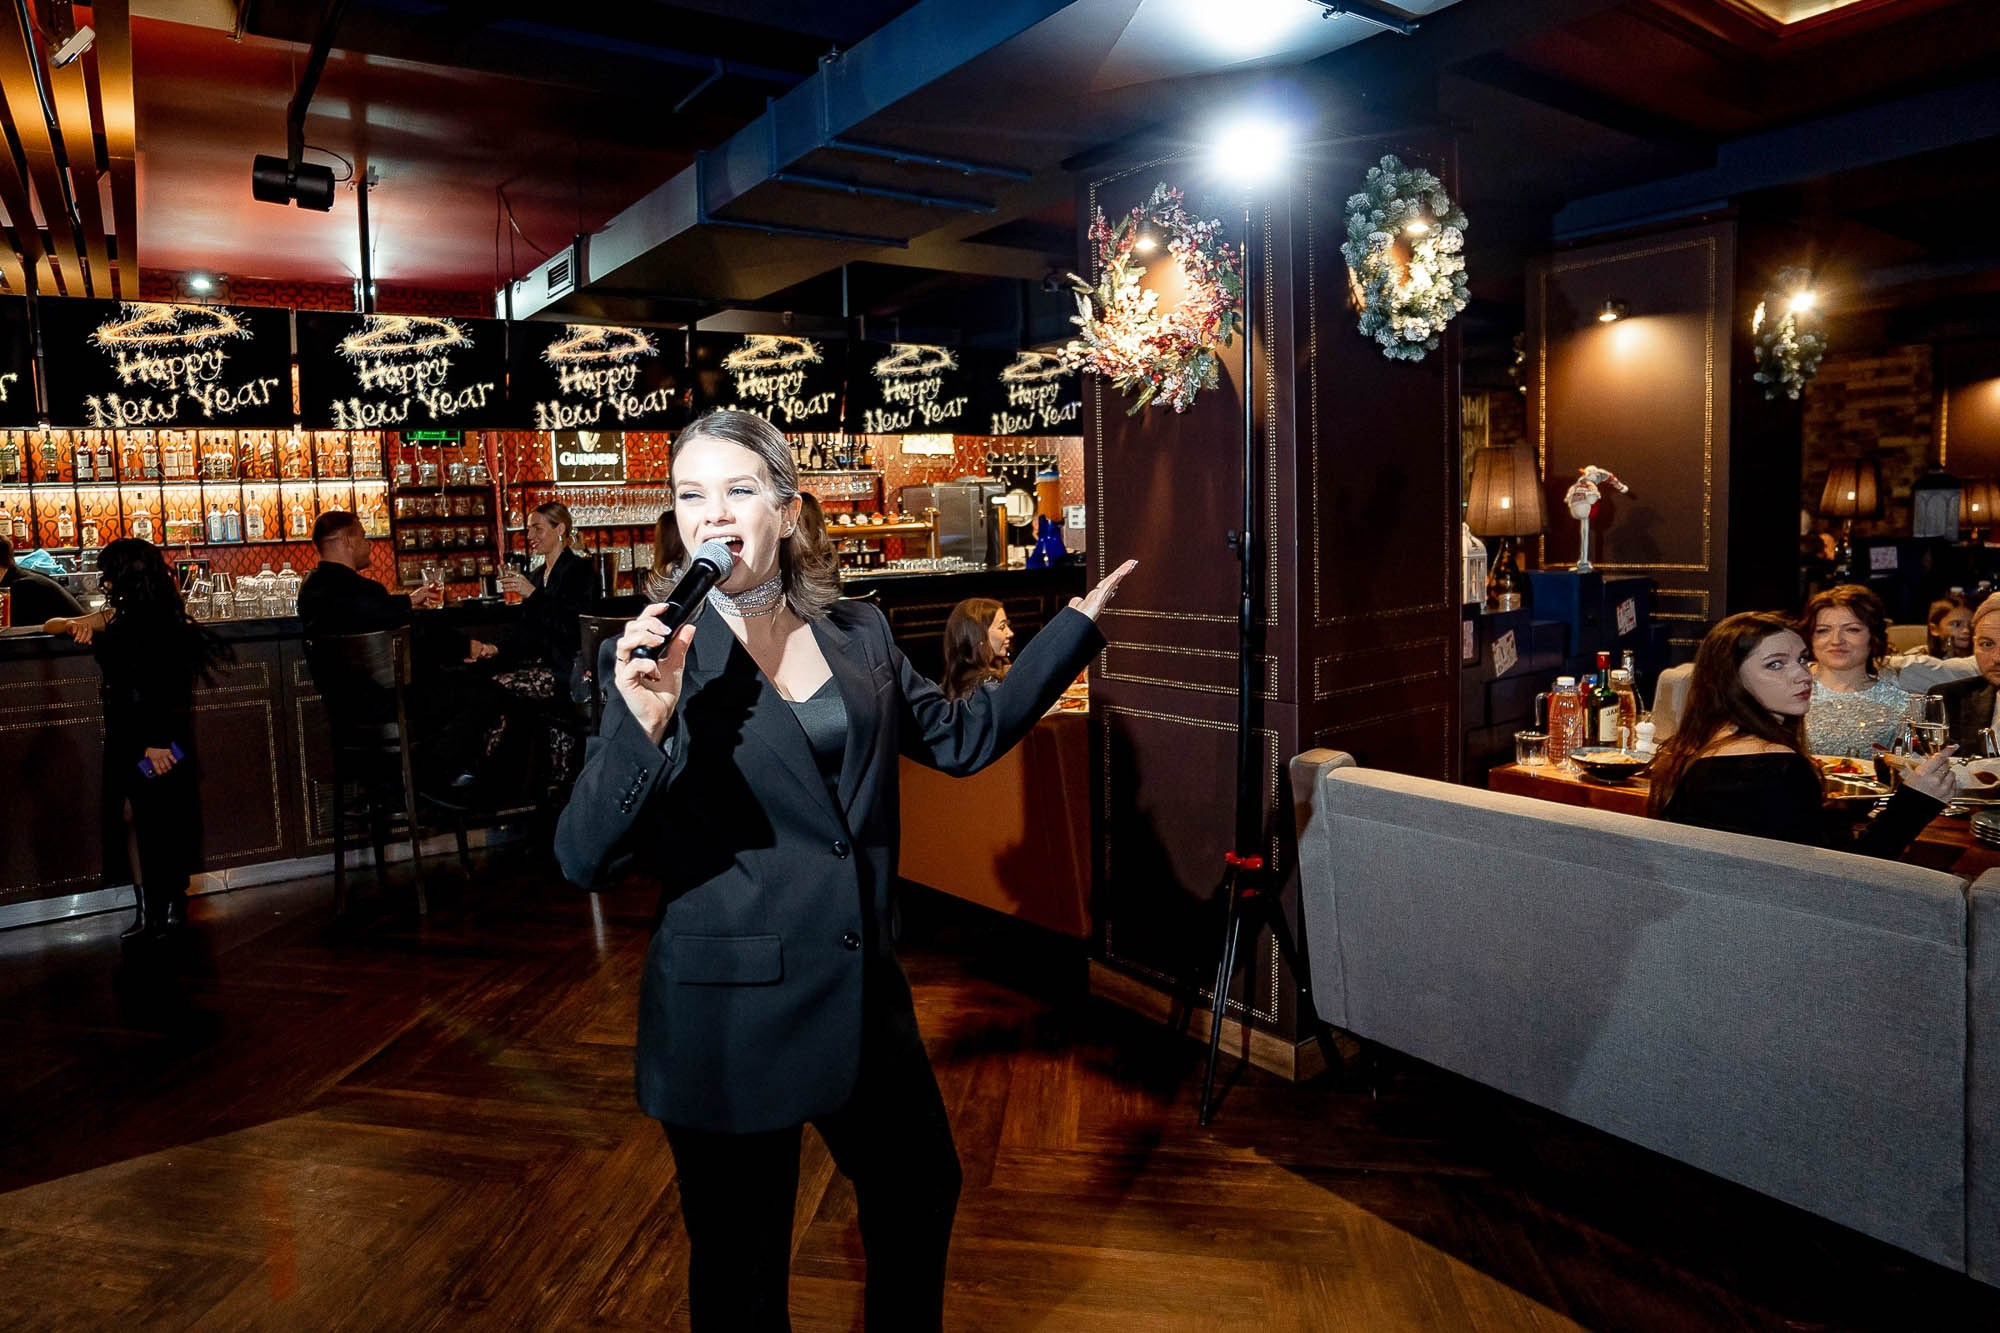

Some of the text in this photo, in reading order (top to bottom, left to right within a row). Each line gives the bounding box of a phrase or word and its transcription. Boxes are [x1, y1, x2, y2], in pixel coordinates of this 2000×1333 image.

[115, 352, 230, 387] Happy
[358, 356, 455, 392] Happy
[558, 366, 640, 397] Happy
[736, 372, 807, 399] Happy
[83, 378, 279, 427] New Year
[331, 381, 495, 429] New Year
[777, 391, 836, 423] Year
[881, 378, 943, 403] Happy
[1007, 382, 1061, 406] Happy
[534, 400, 602, 430] New
[609, 388, 675, 420] Year
[864, 396, 969, 434] New Year
[990, 400, 1082, 436] New Year
